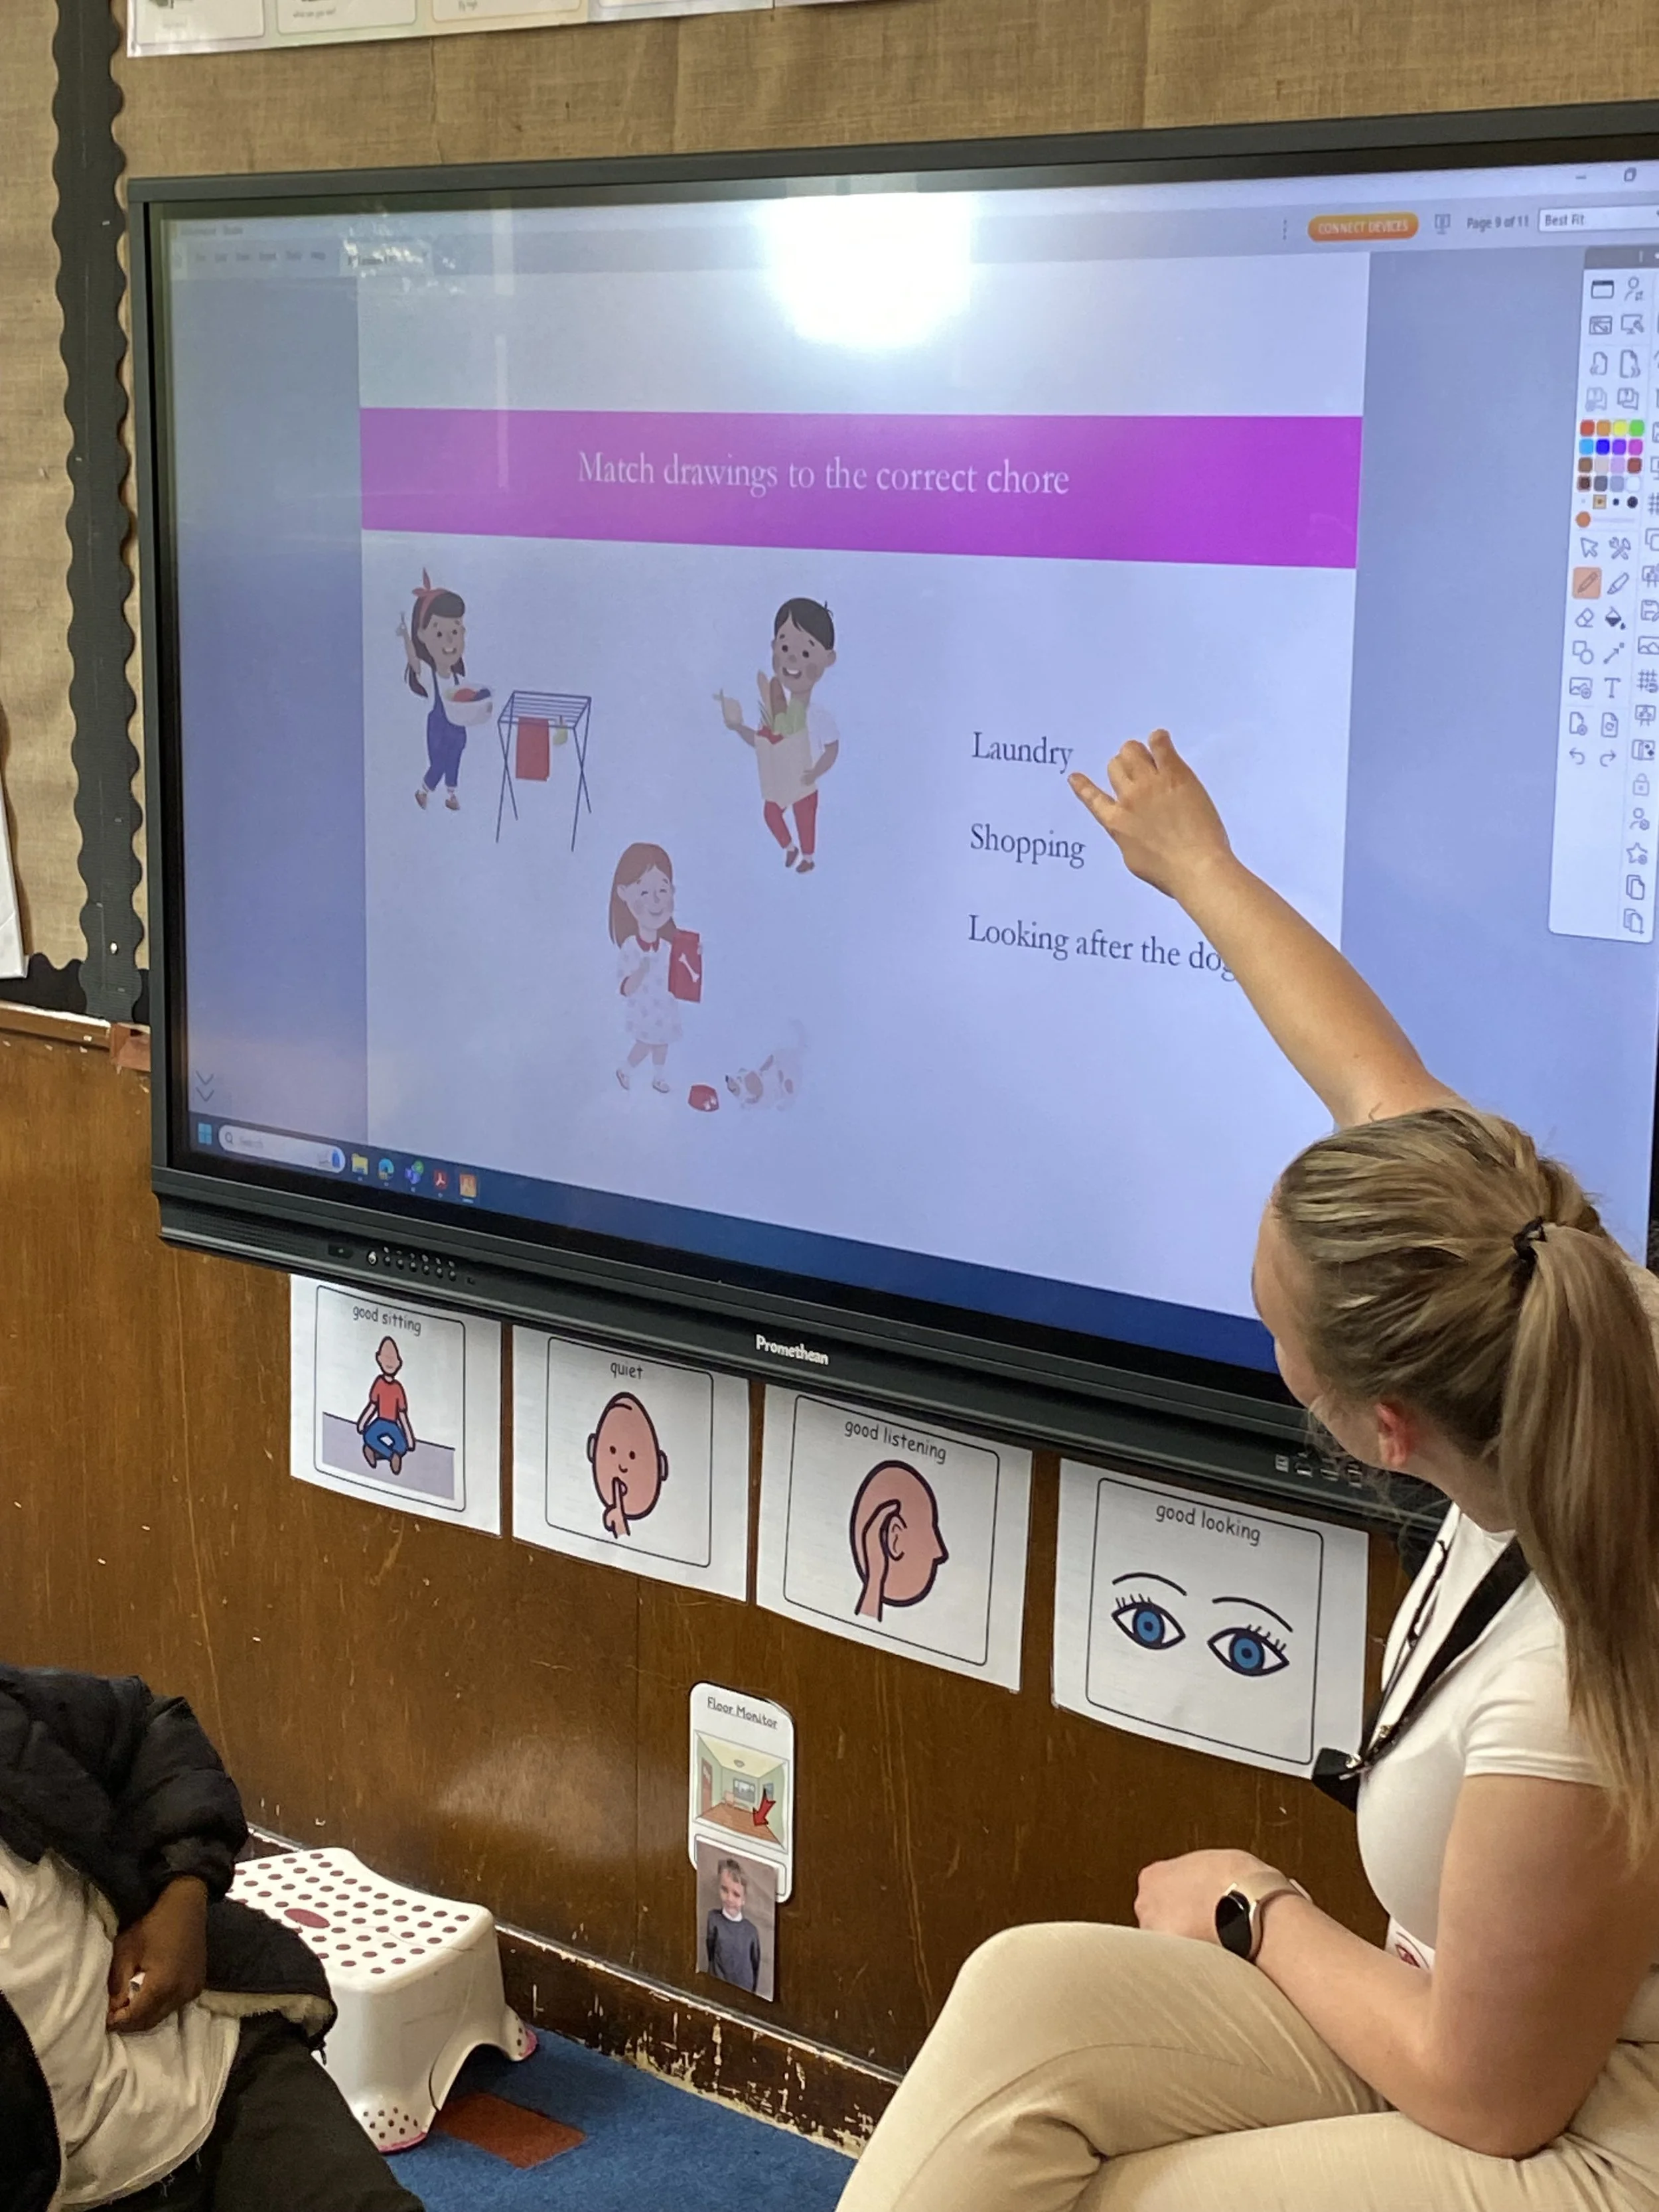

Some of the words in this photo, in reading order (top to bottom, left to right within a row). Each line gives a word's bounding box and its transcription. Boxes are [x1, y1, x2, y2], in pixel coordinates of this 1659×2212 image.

[1467, 217, 1492, 232] Page
[1494, 216, 1502, 228] 9
[1504, 216, 1516, 228] of
[1518, 214, 1530, 227] 11
[1545, 214, 1568, 226] Best
[1571, 213, 1585, 225] Fit
[578, 451, 655, 483] Match
[664, 453, 778, 498] drawings
[788, 462, 815, 488] to
[825, 457, 867, 490] the
[875, 463, 979, 492] correct
[986, 459, 1070, 494] chore
[972, 731, 1074, 774] Laundry
[970, 823, 1086, 869] Shopping
[968, 915, 1069, 960] Looking
[1076, 930, 1133, 960] after
[1141, 936, 1181, 966] the
[352, 1305, 379, 1322] good
[382, 1311, 421, 1337] sitting
[756, 1333, 829, 1365] Promethean
[610, 1360, 644, 1379] quiet
[844, 1421, 879, 1440] good
[883, 1426, 947, 1465] listening
[1155, 1505, 1196, 1526] good
[1201, 1510, 1261, 1547] looking
[707, 1696, 733, 1713] Floor
[737, 1704, 778, 1729] Monitor
